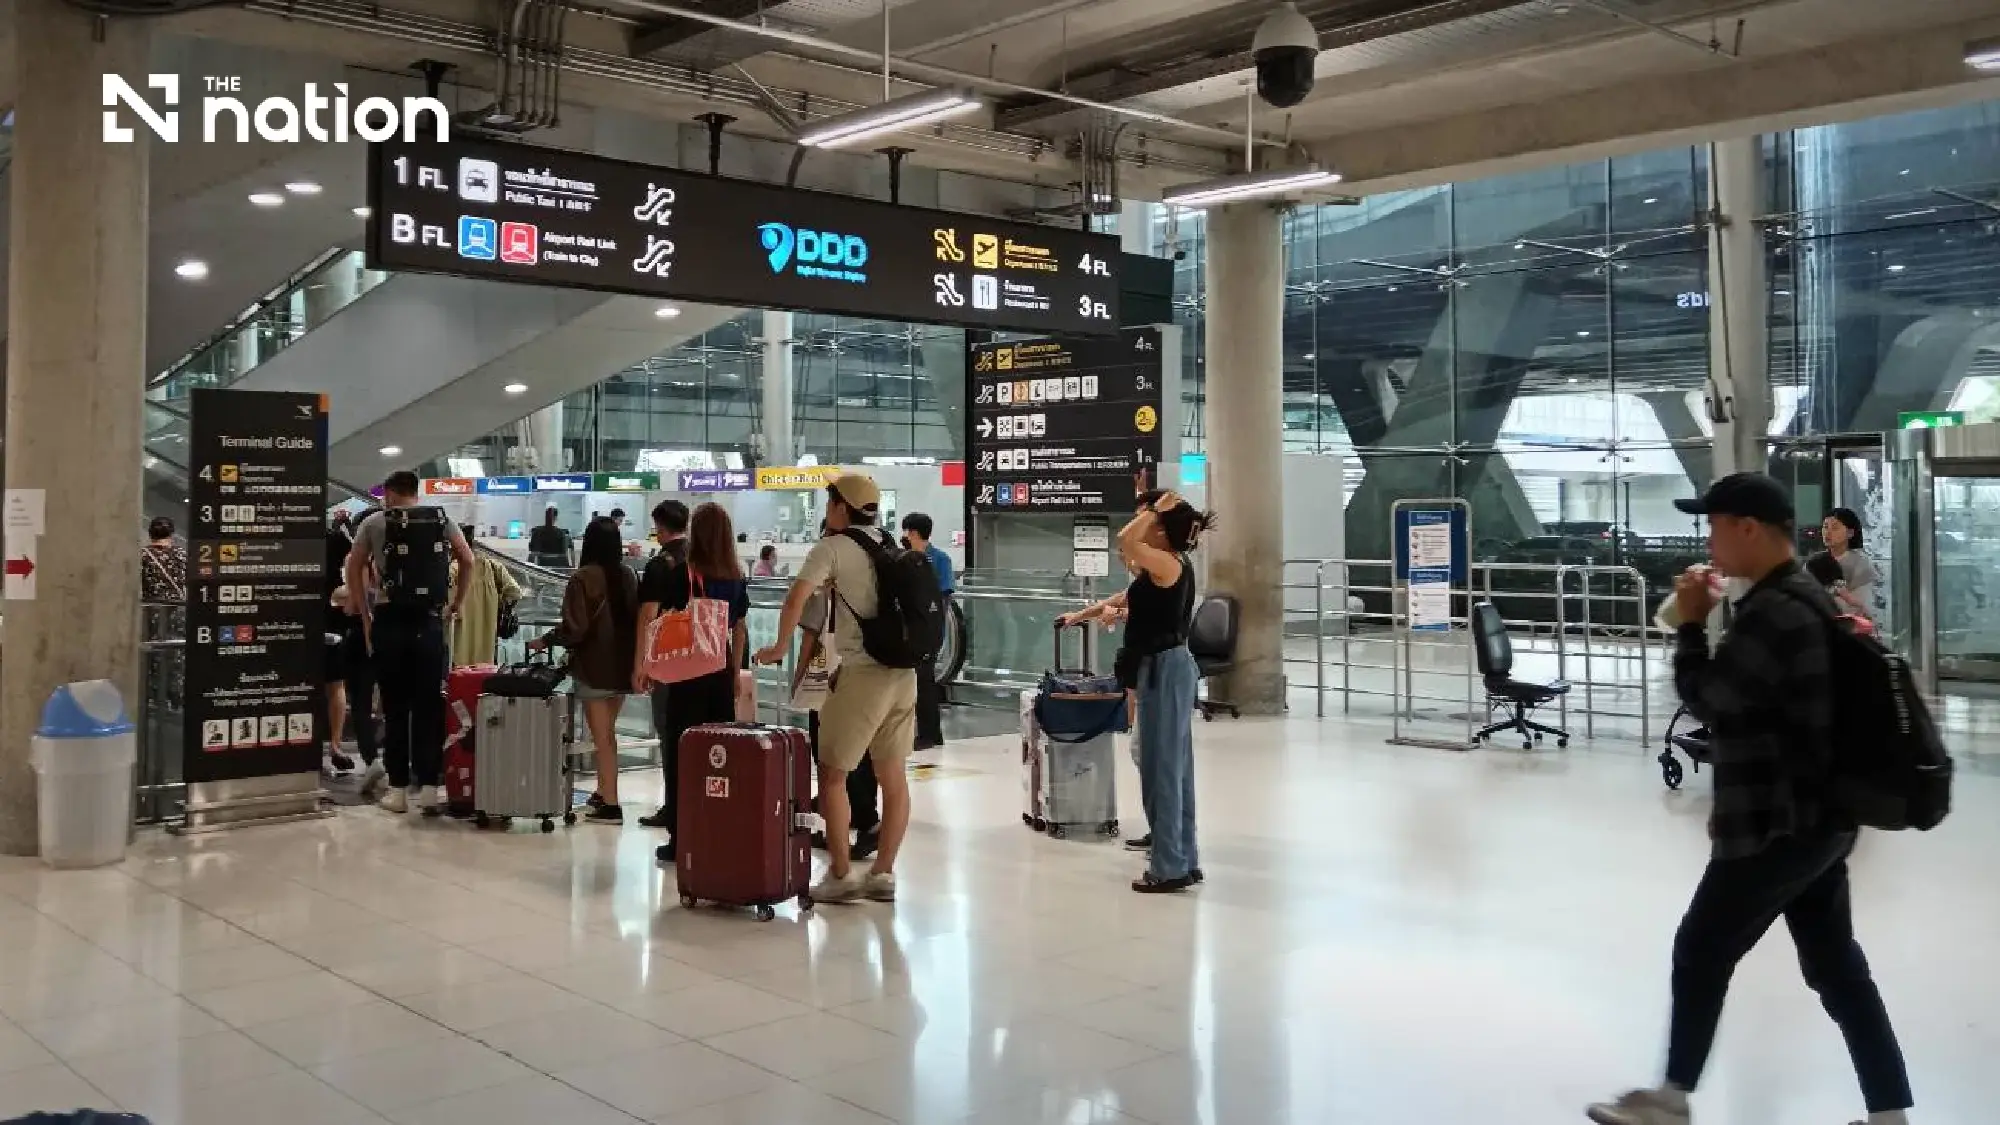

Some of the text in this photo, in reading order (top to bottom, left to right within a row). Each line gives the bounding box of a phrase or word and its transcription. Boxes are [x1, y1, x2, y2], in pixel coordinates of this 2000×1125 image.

[393, 156, 448, 190] 1 FL
[391, 213, 451, 247] B FL
[797, 228, 868, 267] DDD
[1077, 253, 1092, 275] 4
[1093, 260, 1112, 277] FL
[1079, 294, 1112, 320] 3 FL
[1135, 336, 1144, 351] 4
[1136, 375, 1146, 390] 3
[218, 435, 314, 450] Terminal Guide
[1136, 447, 1144, 463] 1
[199, 464, 213, 479] 4
[200, 505, 213, 522] 3
[199, 545, 212, 562] 2
[199, 585, 209, 603] 1
[197, 627, 212, 643] B
